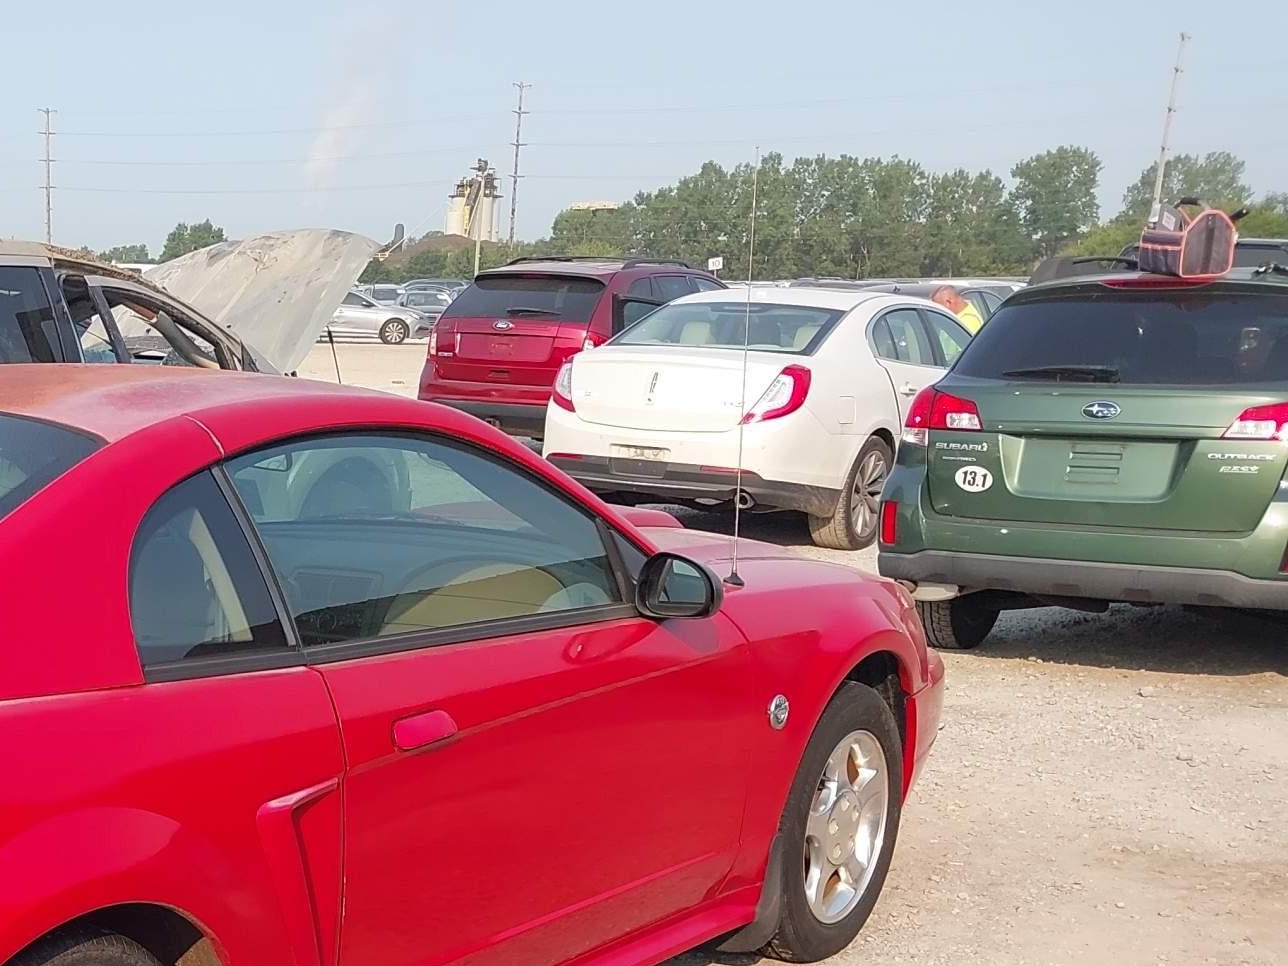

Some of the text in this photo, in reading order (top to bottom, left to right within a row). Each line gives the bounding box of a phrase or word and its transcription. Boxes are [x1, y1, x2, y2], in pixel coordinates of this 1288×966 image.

[935, 442, 988, 452] SUBARU
[1207, 453, 1278, 461] OUTBACK
[961, 470, 988, 488] 13.1
